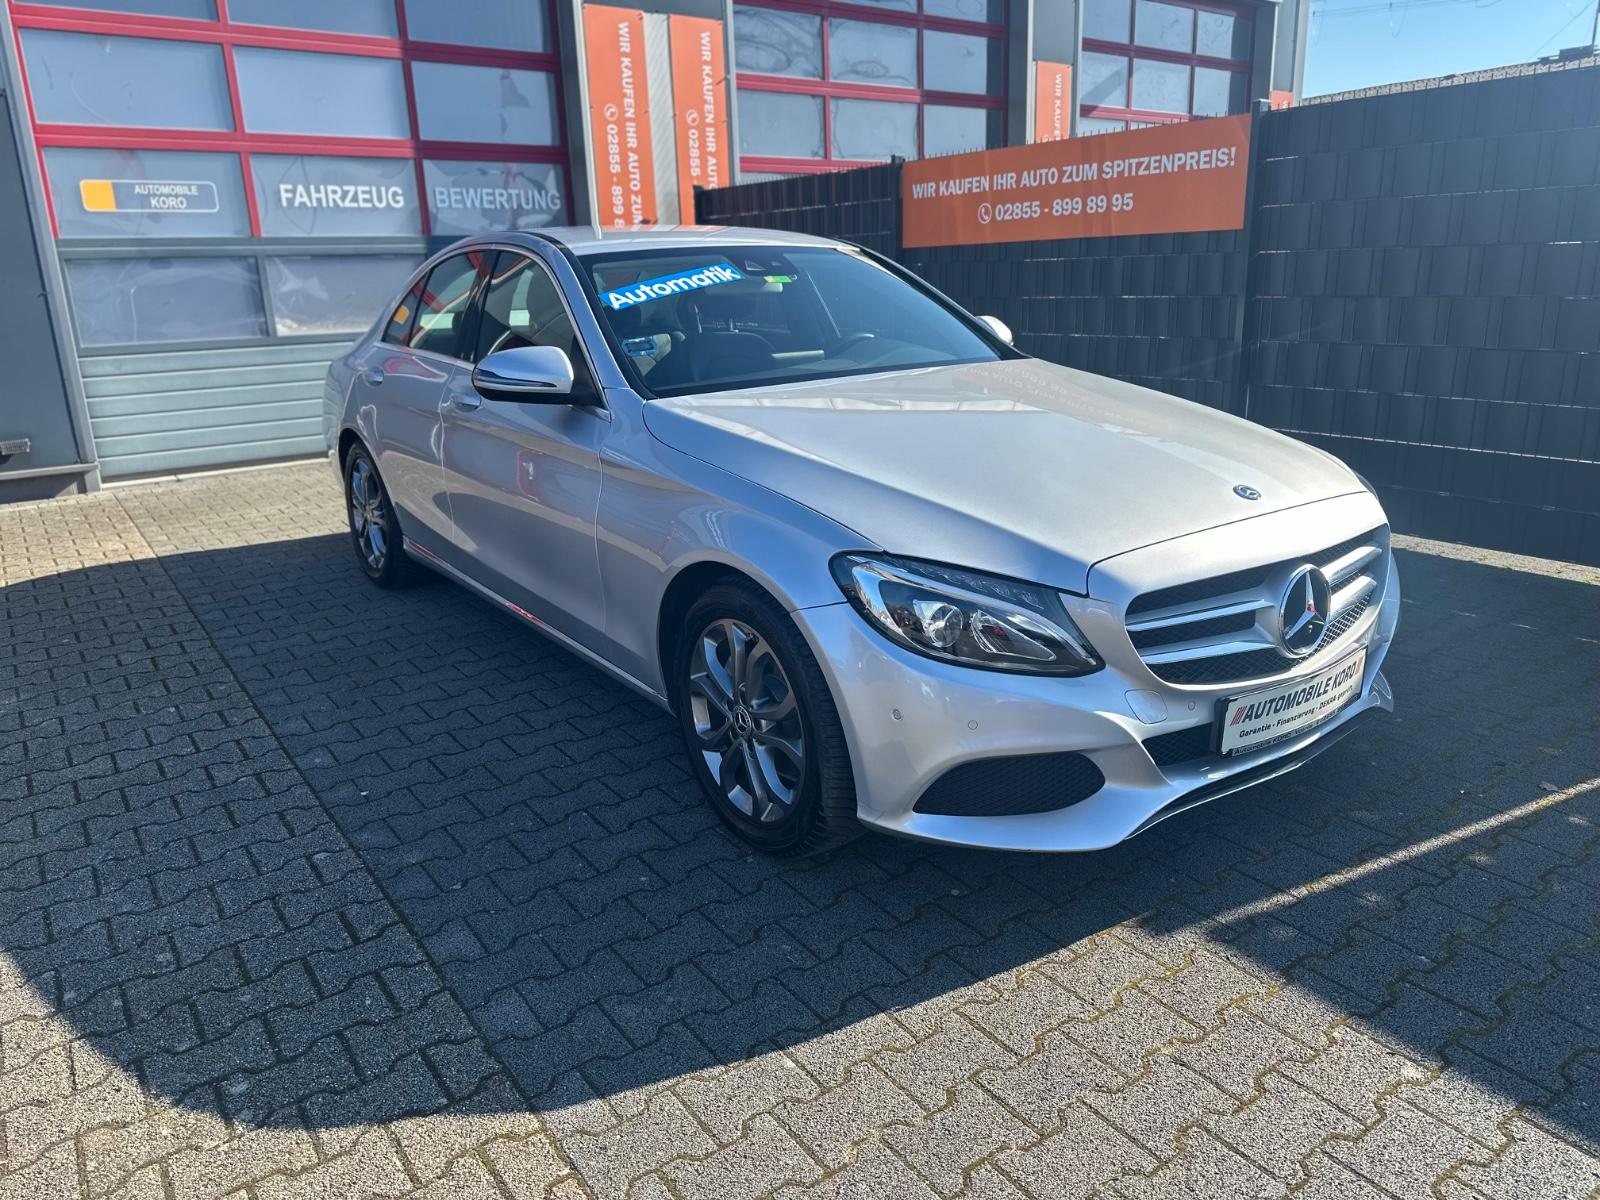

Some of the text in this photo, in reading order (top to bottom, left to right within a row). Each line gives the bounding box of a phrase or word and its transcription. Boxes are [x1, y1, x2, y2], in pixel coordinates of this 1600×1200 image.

[618, 22, 631, 53] WIR
[700, 32, 711, 61] WIR
[620, 57, 635, 118] KAUFEN
[702, 65, 715, 124] KAUFEN
[606, 124, 620, 174] 02855
[626, 122, 638, 149] IHR
[705, 127, 716, 152] IHR
[688, 131, 700, 177] 02855
[627, 152, 640, 192] AUTO
[912, 147, 1236, 199] WIR KAUFEN IHR AUTO ZUM SPITZENPREIS!
[134, 184, 198, 196] AUTOMOBILE
[150, 196, 188, 208] KORO
[280, 184, 404, 208] FAHRZEUG
[435, 186, 561, 210] BEWERTUNG
[612, 185, 624, 215] 899
[995, 201, 1040, 221] 02855
[1052, 196, 1082, 216] 899
[1086, 195, 1107, 214] 89
[1112, 192, 1134, 212] 95
[608, 266, 741, 308] Automatik
[1242, 676, 1332, 722] AUTOMOBILE
[1330, 661, 1357, 690] KORO
[1239, 724, 1271, 738] Garantie
[1276, 708, 1316, 728] Finanzierung
